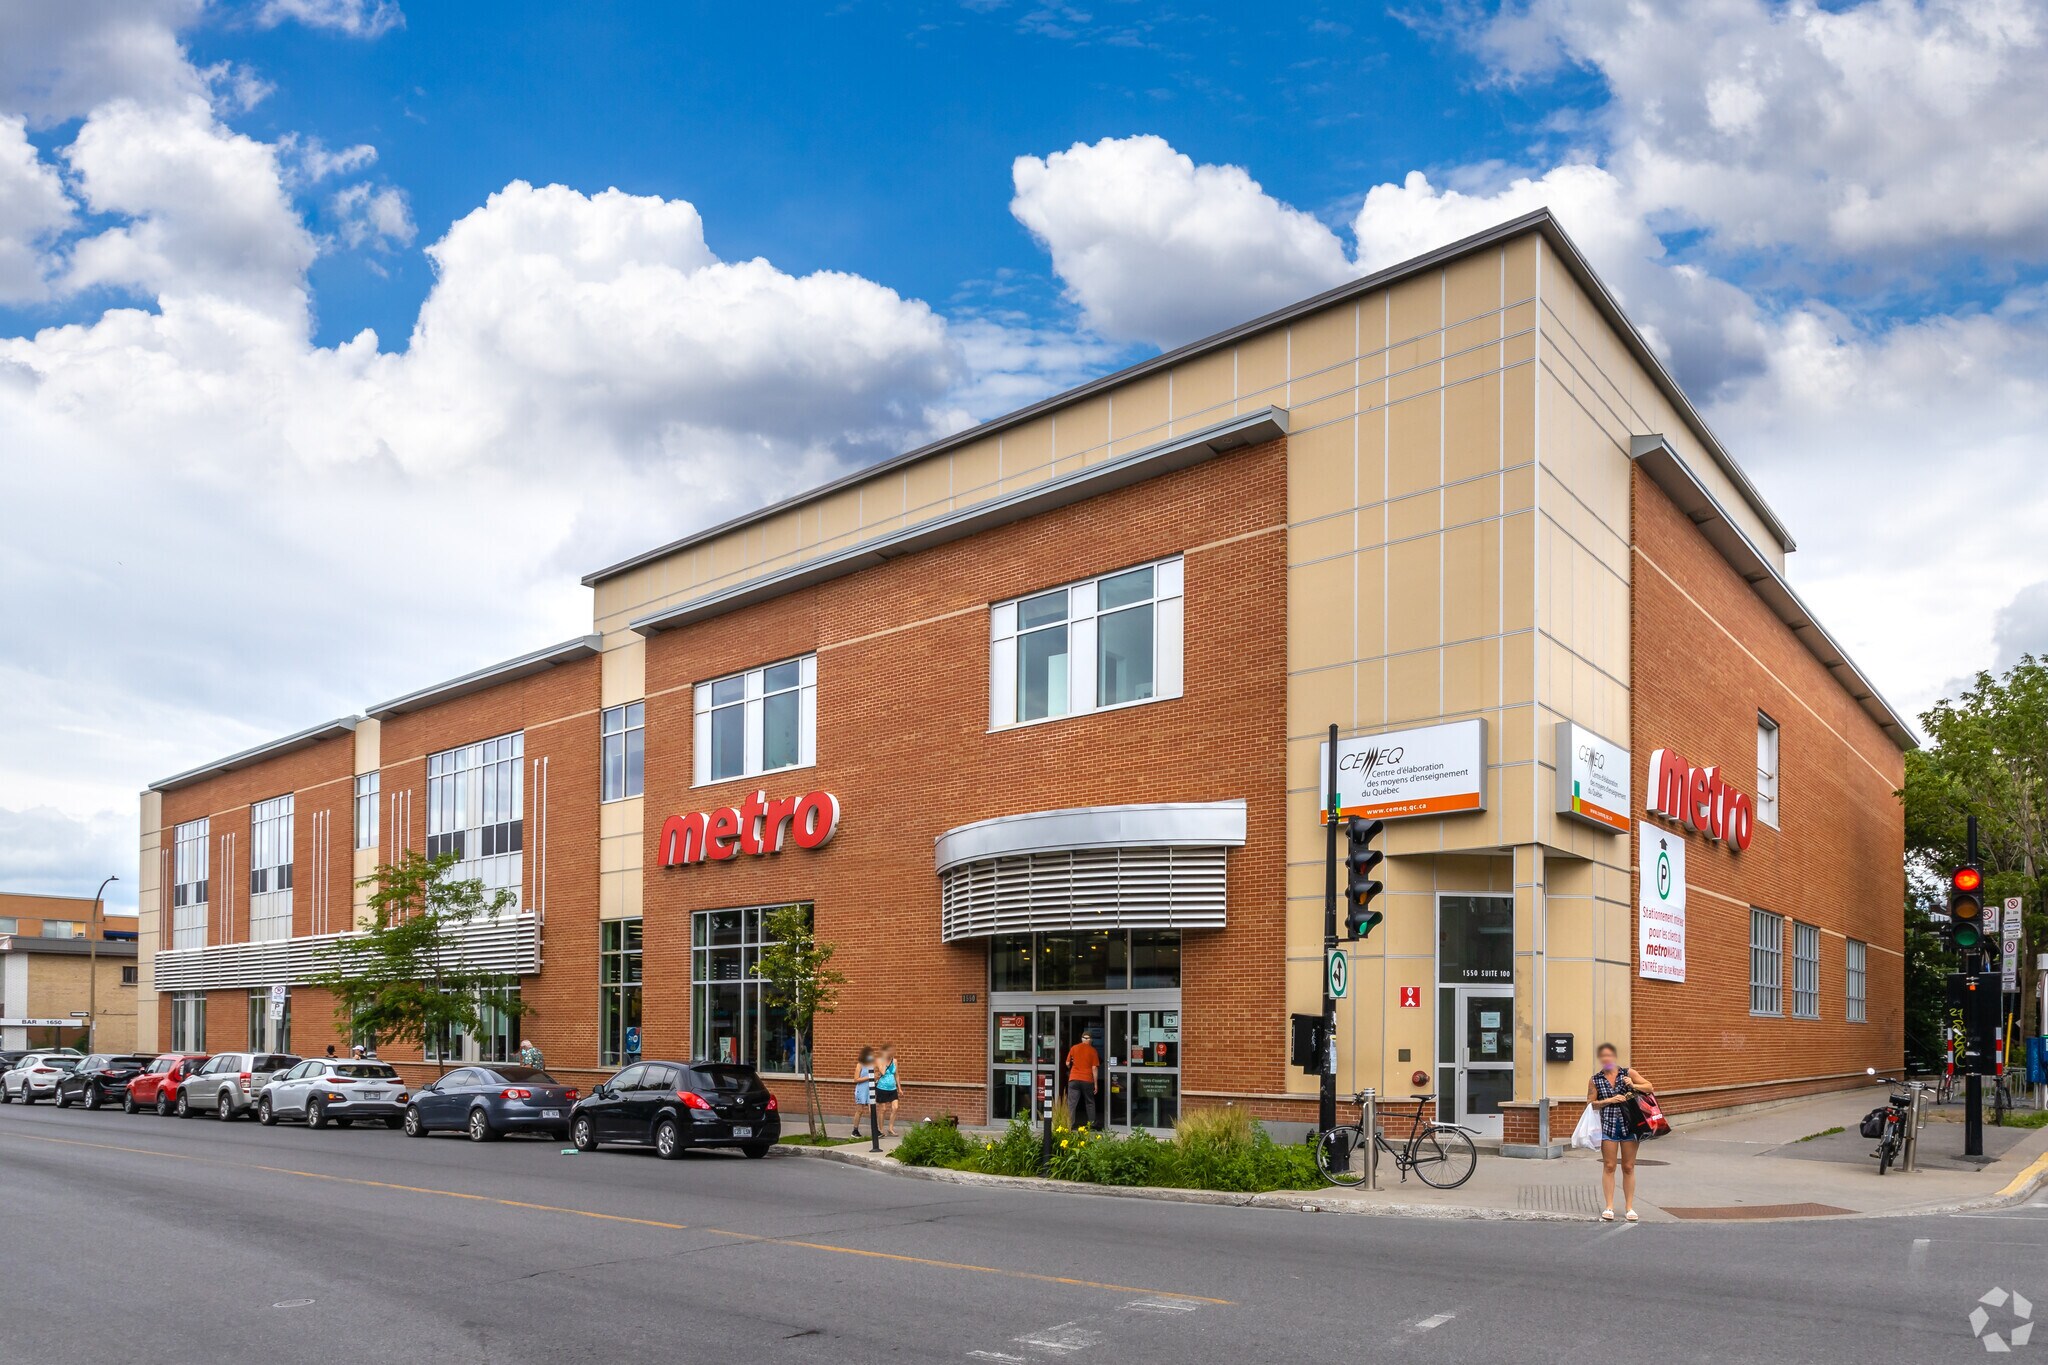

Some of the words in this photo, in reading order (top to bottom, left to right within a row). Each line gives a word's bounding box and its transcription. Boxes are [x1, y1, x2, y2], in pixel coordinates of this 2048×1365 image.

[1367, 779, 1379, 788] des
[1380, 777, 1409, 788] moyens
[1409, 768, 1469, 783] d'enseignement
[1372, 769, 1395, 778] Centre
[1397, 763, 1444, 775] d'élaboration
[1361, 790, 1371, 798] du
[1372, 786, 1400, 797] Québec
[1647, 748, 1752, 850] metro
[1366, 803, 1427, 815] www.cemeq.qc.ca
[657, 790, 840, 866] metro
[1642, 906, 1674, 922] Stationnement
[1648, 927, 1661, 940] pour
